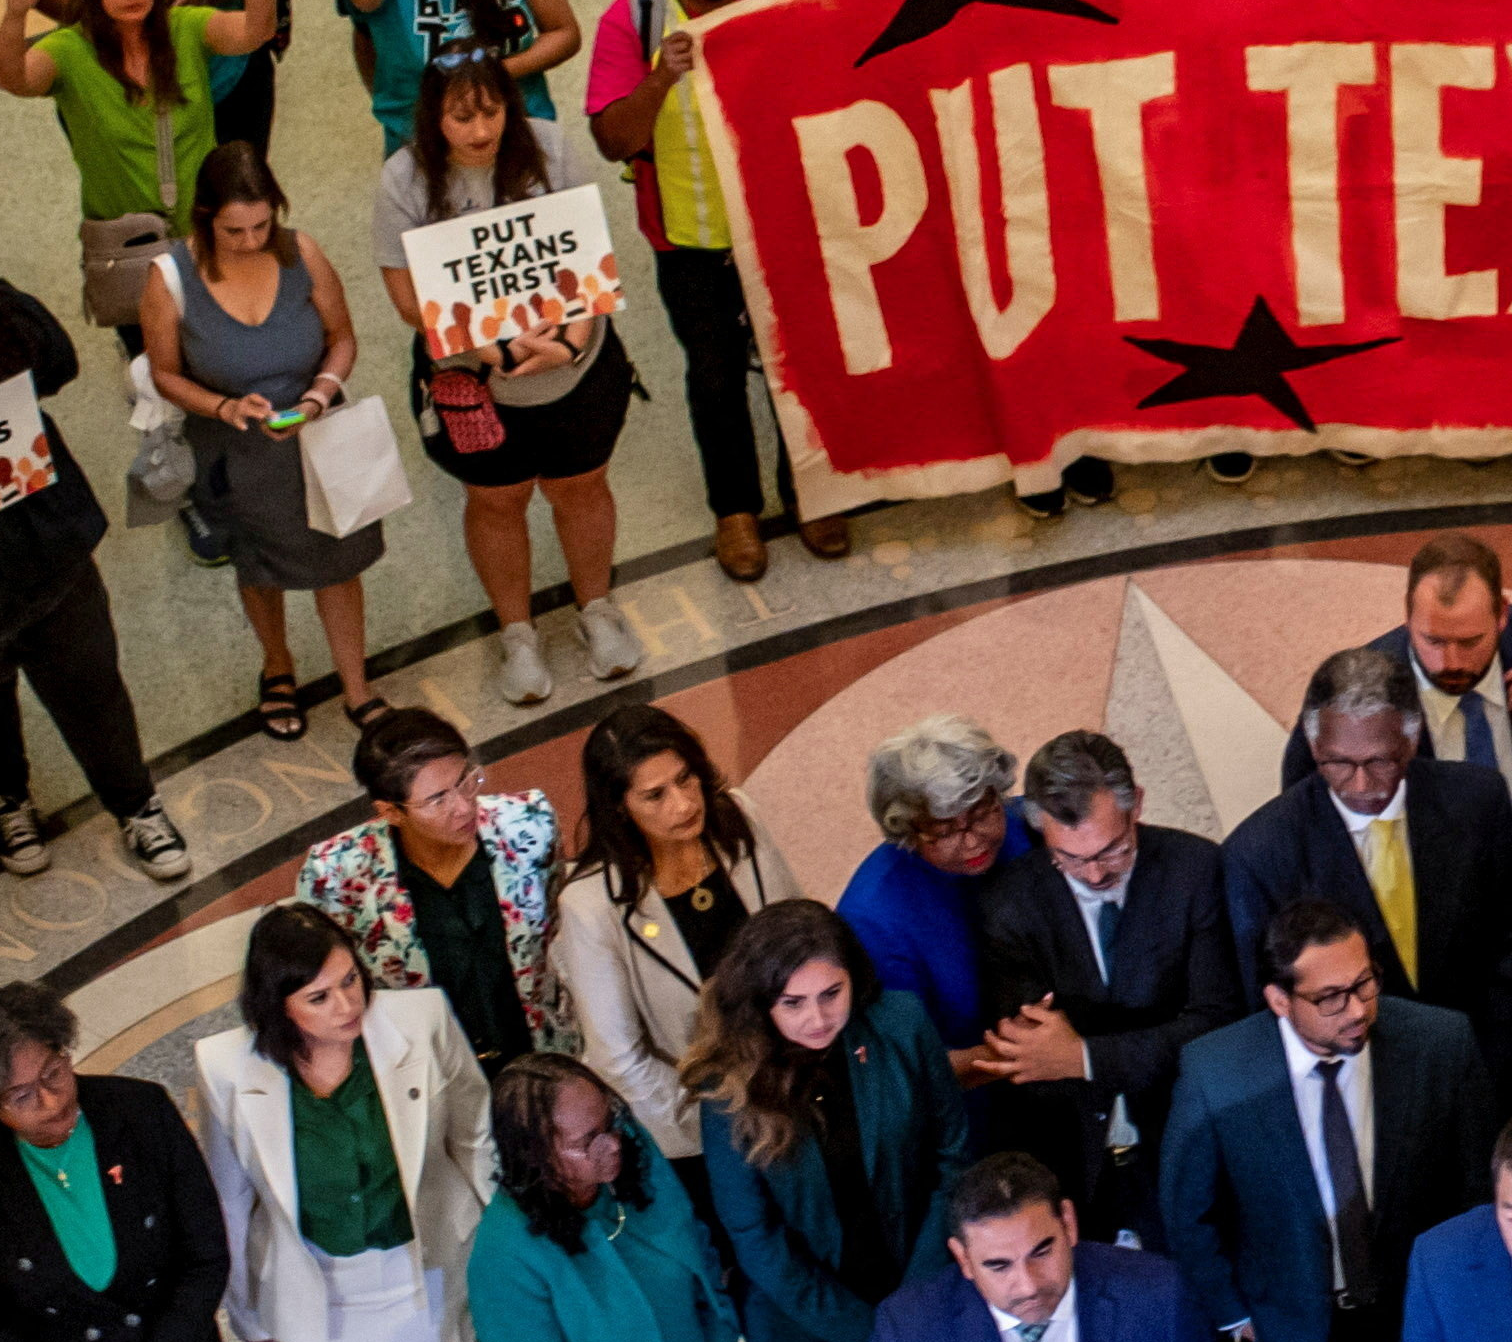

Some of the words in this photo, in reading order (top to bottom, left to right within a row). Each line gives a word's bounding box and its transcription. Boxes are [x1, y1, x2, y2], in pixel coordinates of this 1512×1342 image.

[472, 213, 536, 249] PUT
[791, 52, 1178, 378] PUT
[443, 229, 578, 285] TEXANS
[472, 261, 562, 305] FIRST
